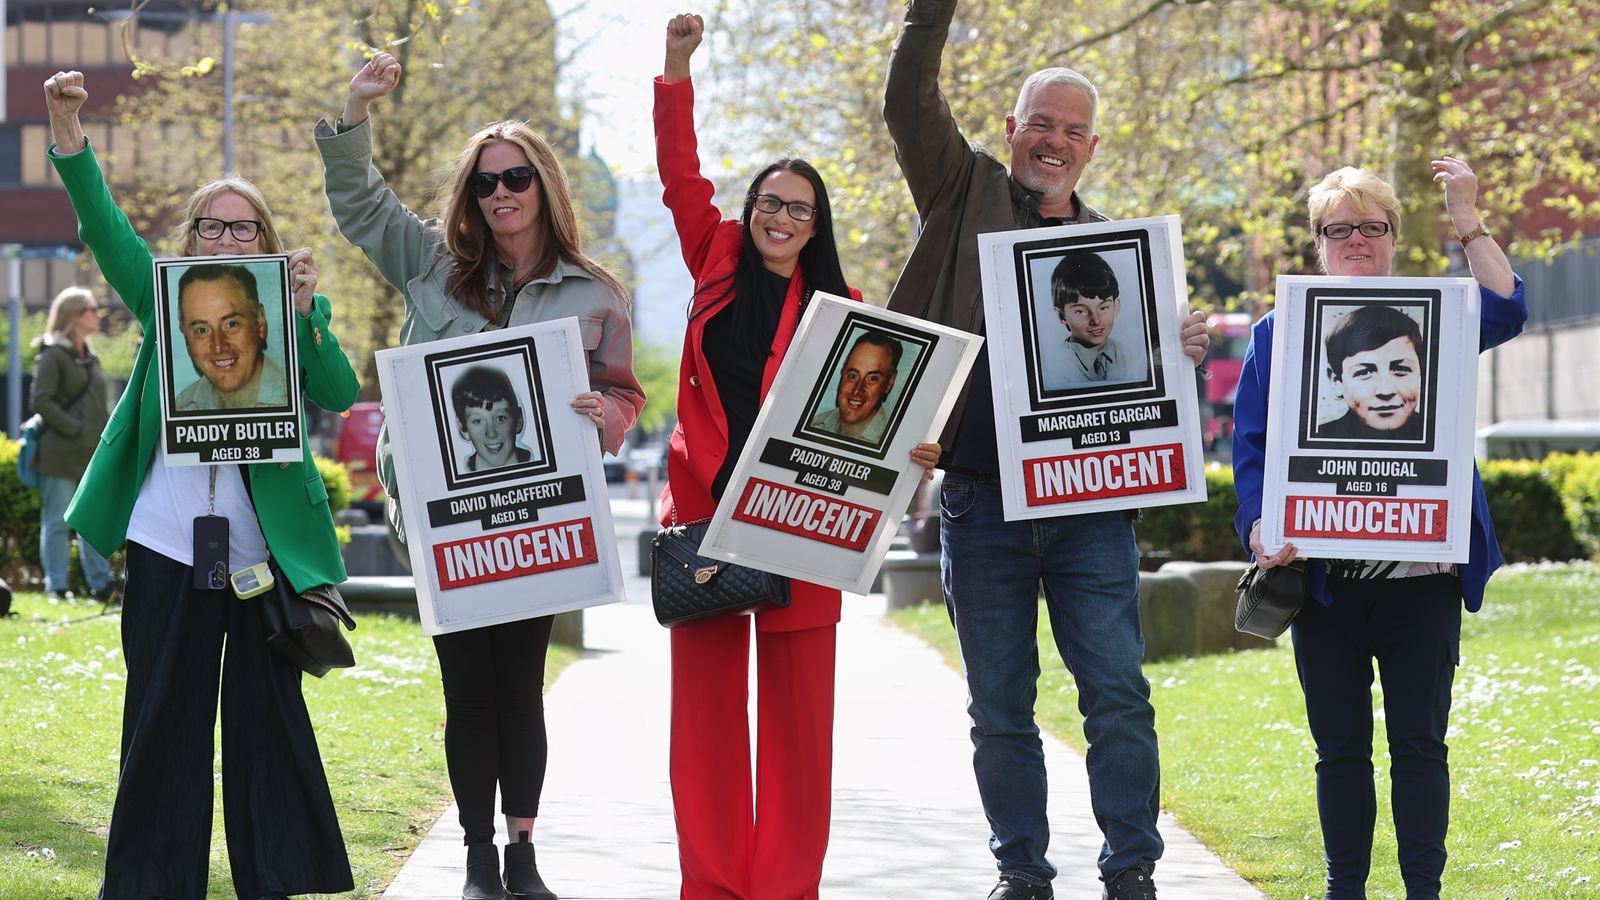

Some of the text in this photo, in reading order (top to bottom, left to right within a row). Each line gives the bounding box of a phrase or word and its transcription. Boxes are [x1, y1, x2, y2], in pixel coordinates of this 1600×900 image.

[1038, 406, 1160, 432] MARGARET GARGAN
[176, 422, 295, 443] PADDY BUTLER
[1080, 430, 1120, 445] AGED 13
[212, 446, 260, 460] AGED 38
[790, 448, 871, 480] PADDY BUTLER
[1032, 448, 1174, 498] INNOCENT
[1318, 460, 1417, 477] JOHN DOUGAL
[802, 472, 842, 491] AGED 38
[1346, 482, 1387, 492] AGED 16
[450, 482, 562, 515] DAVID McCAFFERTY
[492, 508, 528, 525] AGED 15
[744, 482, 873, 543] INNOCENT
[1294, 500, 1438, 534] INNOCENT
[444, 524, 583, 582] INNOCENT
